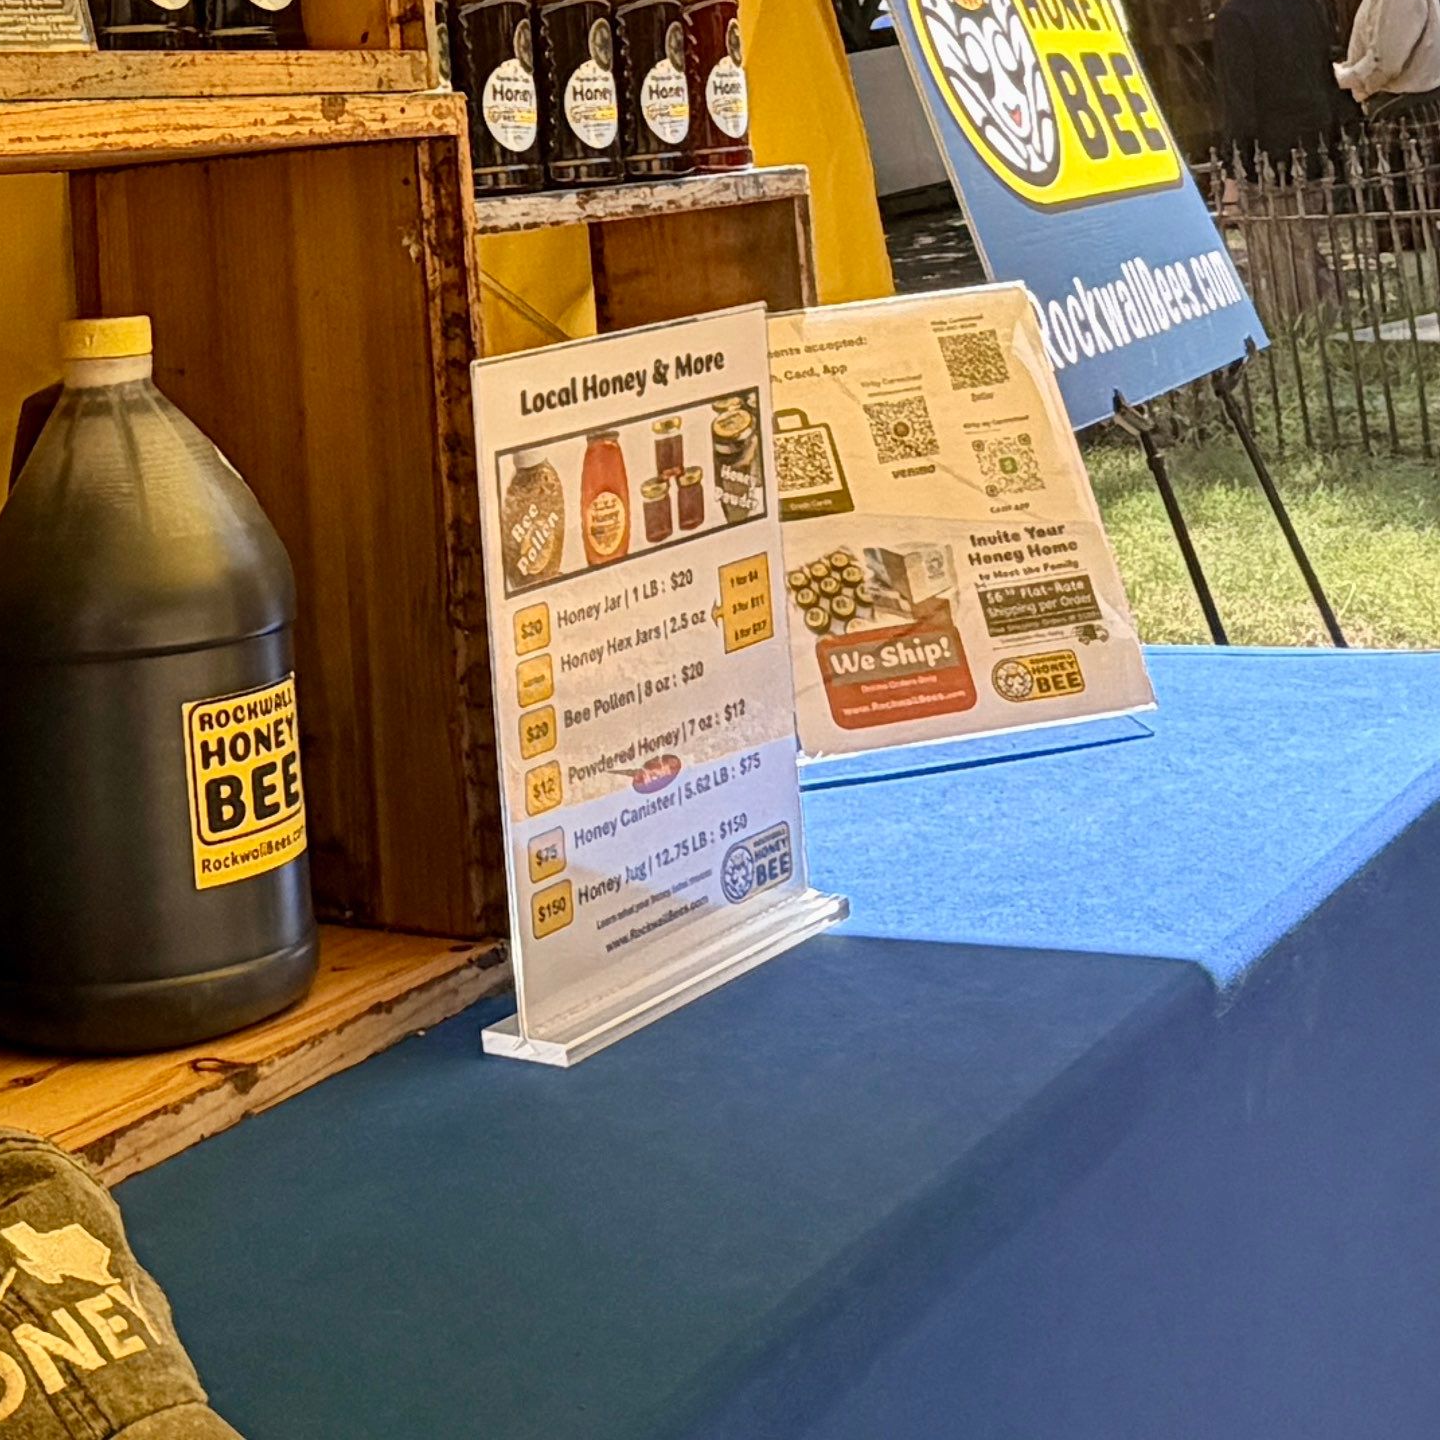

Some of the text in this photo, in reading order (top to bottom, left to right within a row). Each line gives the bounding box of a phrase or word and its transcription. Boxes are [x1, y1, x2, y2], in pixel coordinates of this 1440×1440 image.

[1046, 52, 1167, 160] BEE
[520, 350, 725, 416] Local Honey & More
[968, 540, 1078, 566] Honey Home
[970, 524, 1065, 548] Invite Your
[557, 568, 693, 628] Honey Jar 1 LB $20
[560, 609, 706, 673] Honey Hex Jars 2.5 oz
[830, 636, 952, 675] We Ship!
[1031, 661, 1075, 675] HONEY
[198, 687, 293, 732] ROCKWALL
[564, 661, 704, 729] Bee Pollen 8 oz $20
[1036, 672, 1082, 693] BEE
[200, 713, 296, 771] HONEY
[526, 722, 549, 743] $20
[568, 744, 636, 785] Powdered
[638, 730, 680, 758] Honey
[688, 718, 696, 736] 7
[698, 712, 713, 731] oz
[724, 698, 746, 723] $12
[205, 750, 300, 835] BEE
[574, 751, 761, 849] Honey Canister 5.62 LB $75
[578, 874, 622, 906] Honey
[624, 859, 648, 885] Jug
[655, 839, 689, 868] 12.75
[692, 830, 707, 853] LB
[719, 812, 748, 840] $150
[756, 852, 790, 887] BEE
